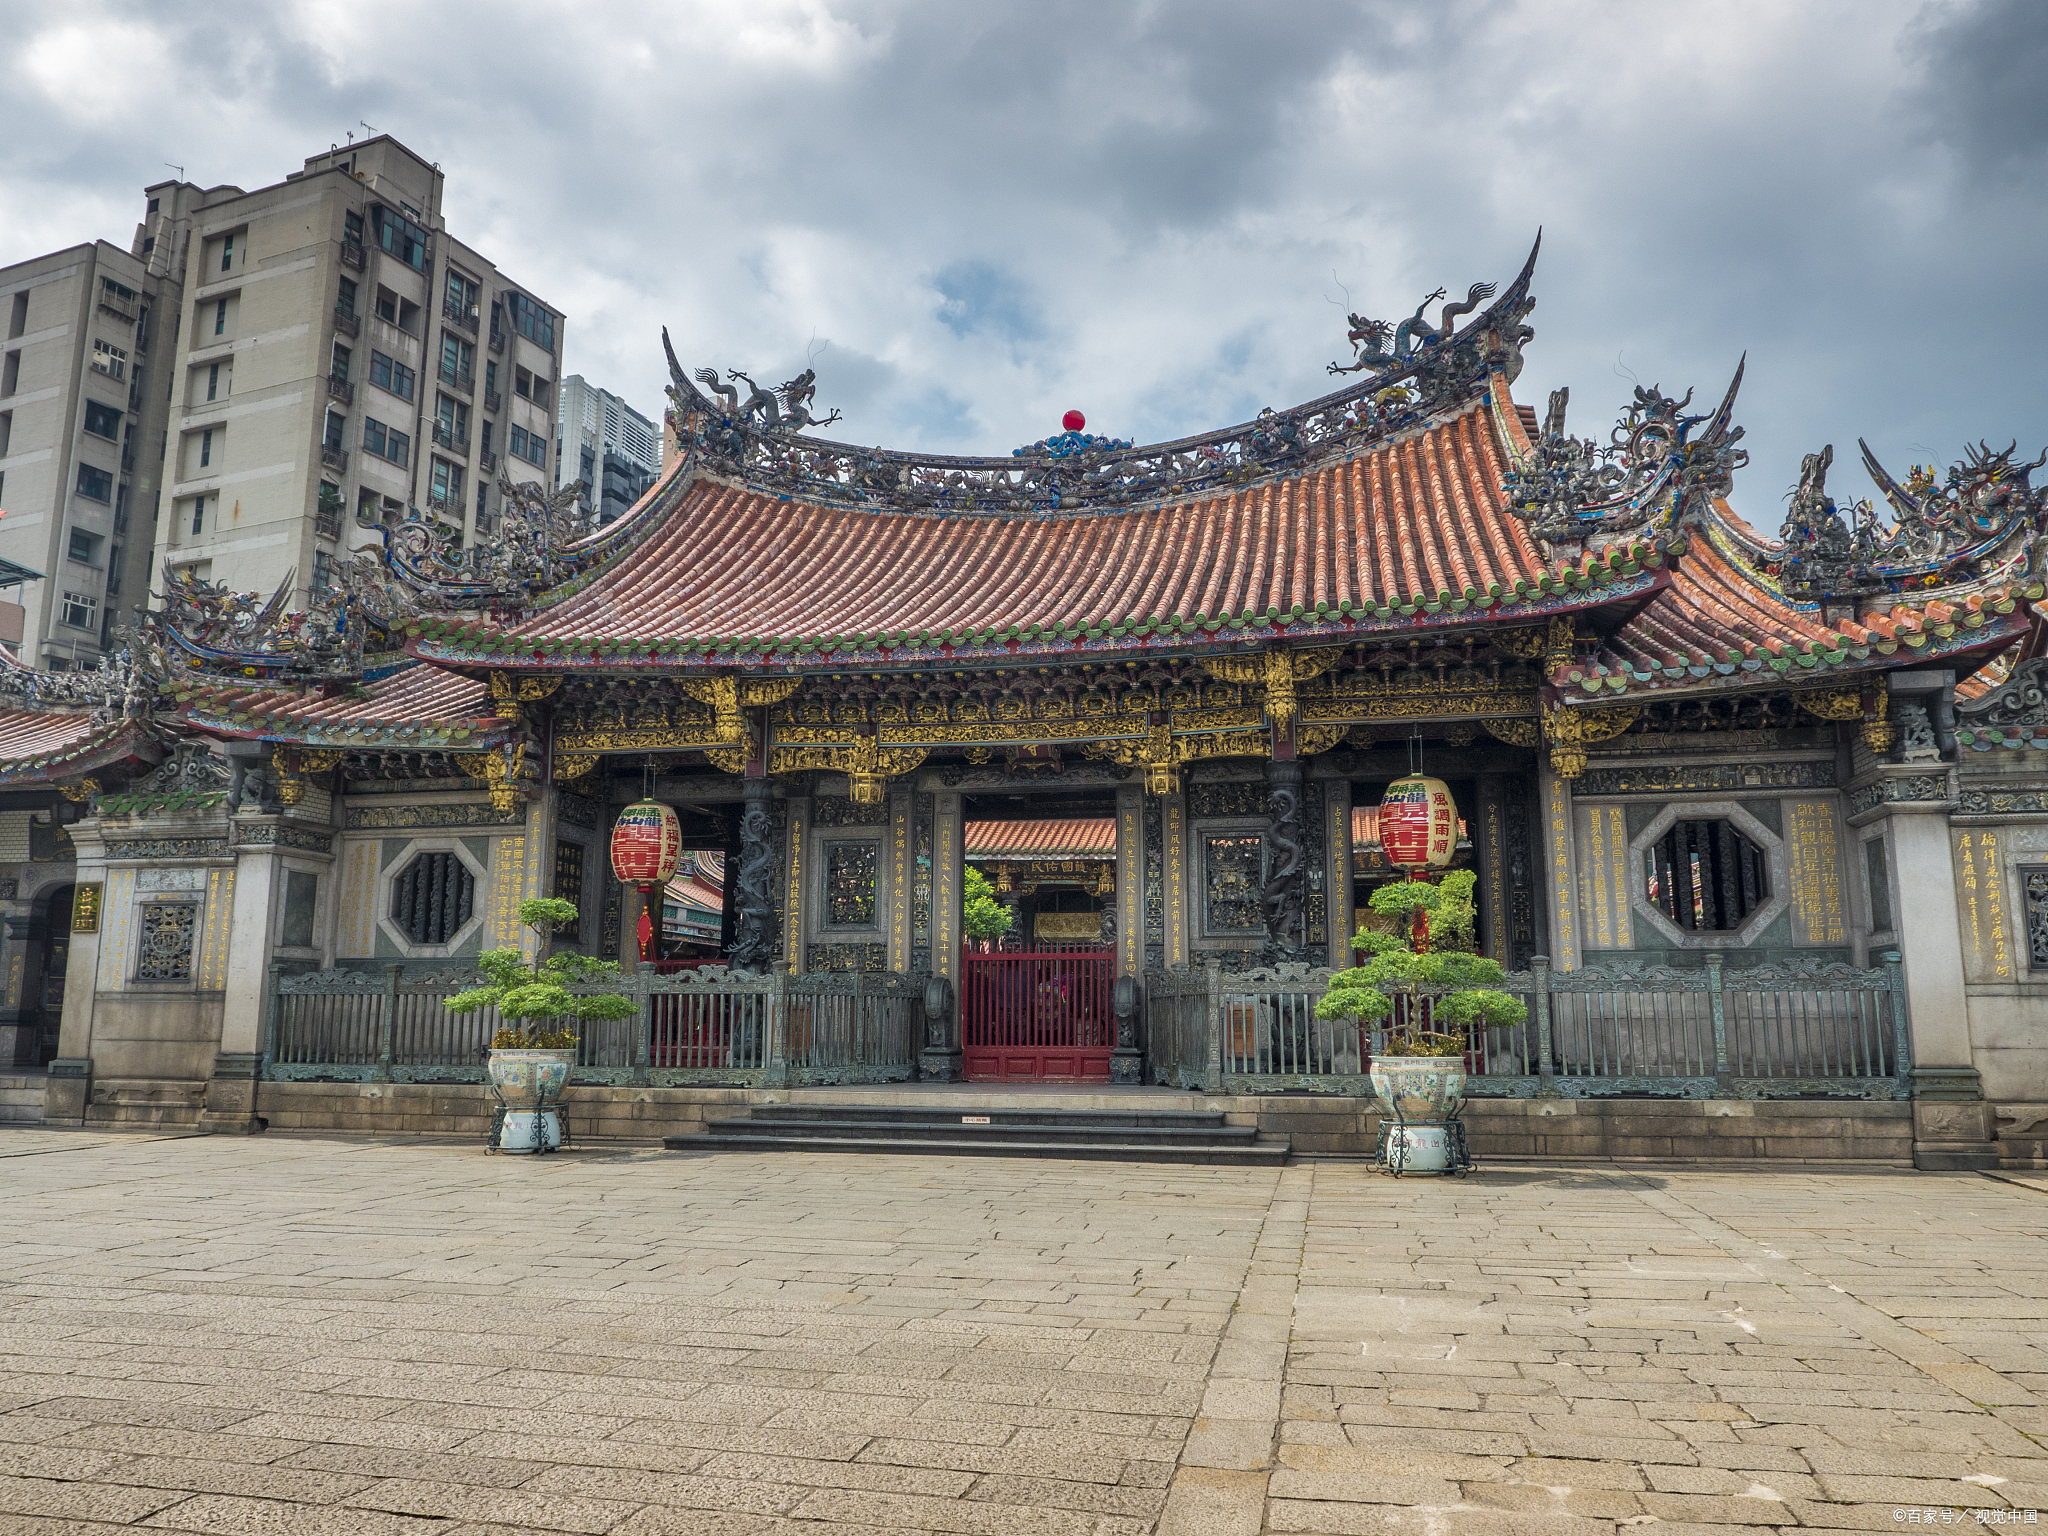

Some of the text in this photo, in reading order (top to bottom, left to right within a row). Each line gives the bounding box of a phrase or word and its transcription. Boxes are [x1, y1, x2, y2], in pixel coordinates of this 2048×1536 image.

[661, 814, 679, 873] 納福呈祥
[1432, 792, 1451, 855] 風調雨順
[76, 919, 93, 927] EXIT
[80, 887, 93, 916] 出口
